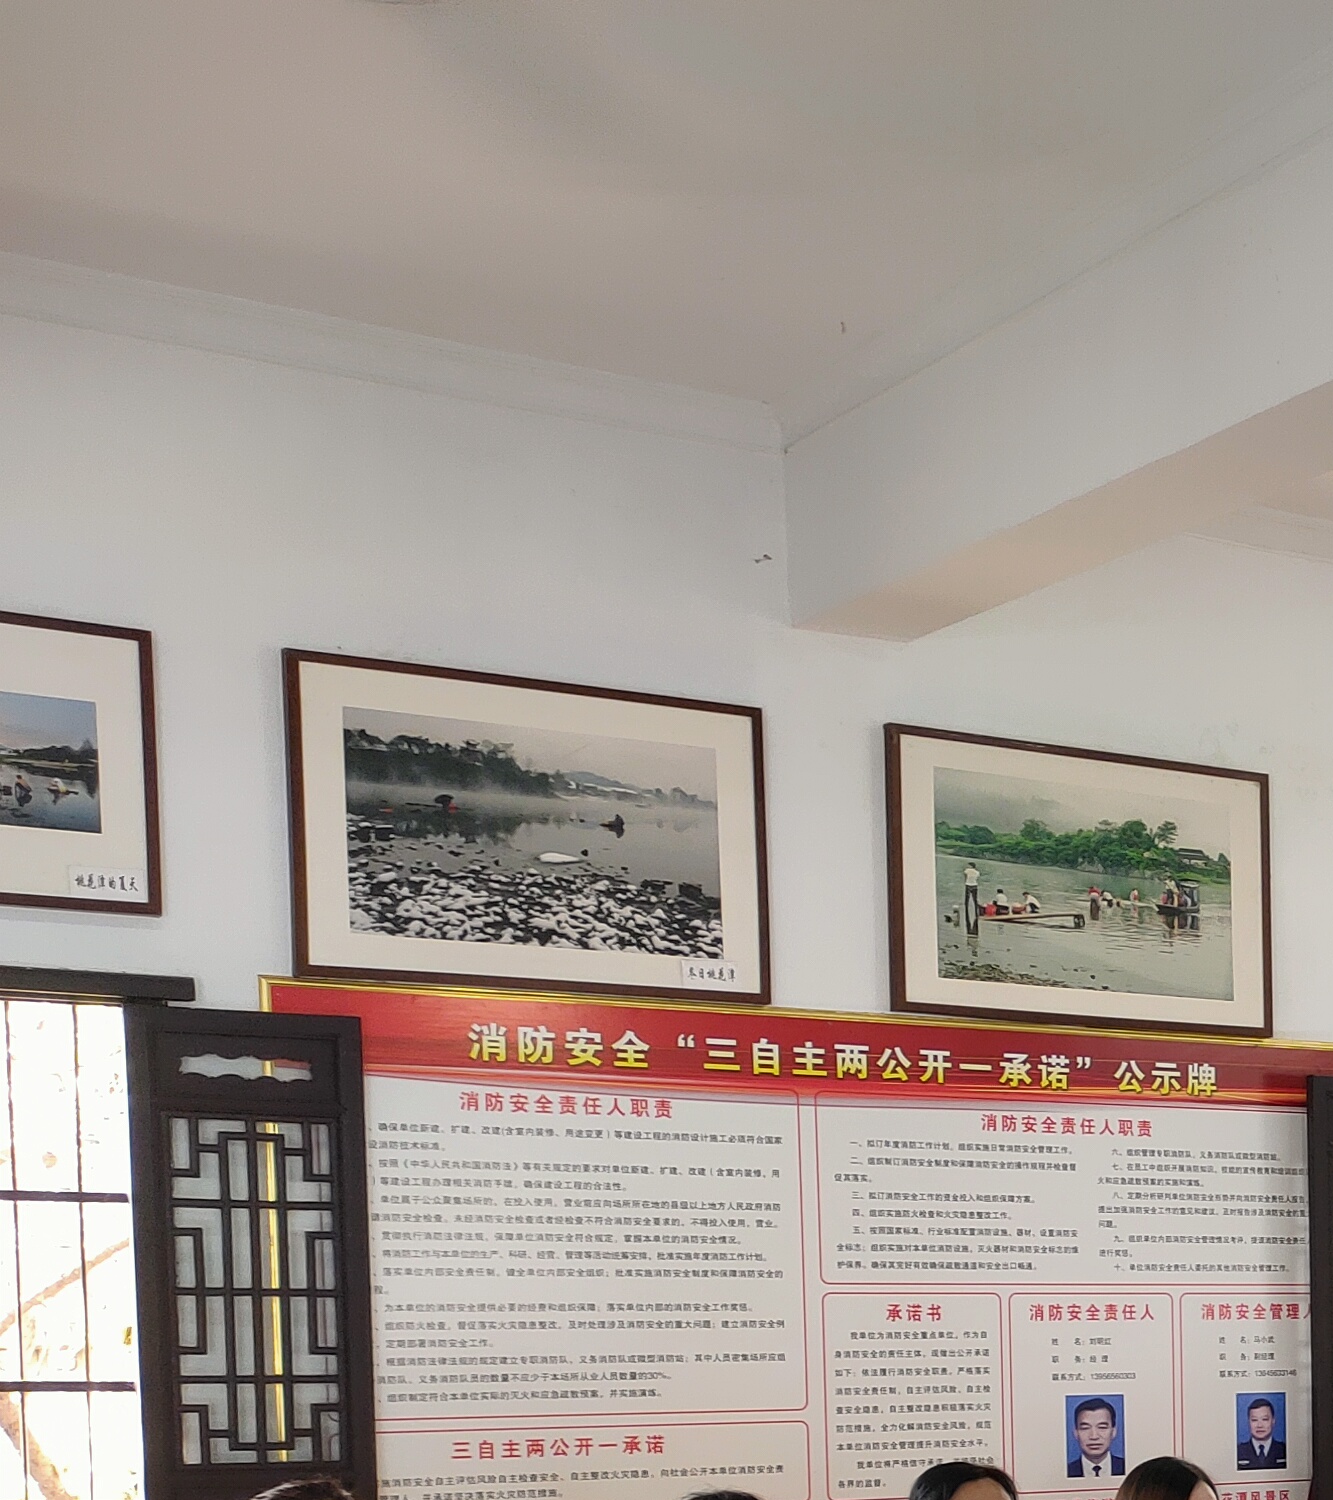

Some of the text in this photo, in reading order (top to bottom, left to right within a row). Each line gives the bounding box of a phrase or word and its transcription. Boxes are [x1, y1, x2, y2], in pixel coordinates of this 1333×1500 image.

[467, 1022, 651, 1069] 消防安全
[1114, 1060, 1218, 1096] 公示牌
[459, 1091, 673, 1119] 消防安全责任人职责
[981, 1113, 1153, 1137] 消防安全责任人职责
[886, 1303, 942, 1322] 承诺书
[1029, 1303, 1155, 1321] 消防安全责任人
[451, 1434, 665, 1460] 三自主两公开一承诺
